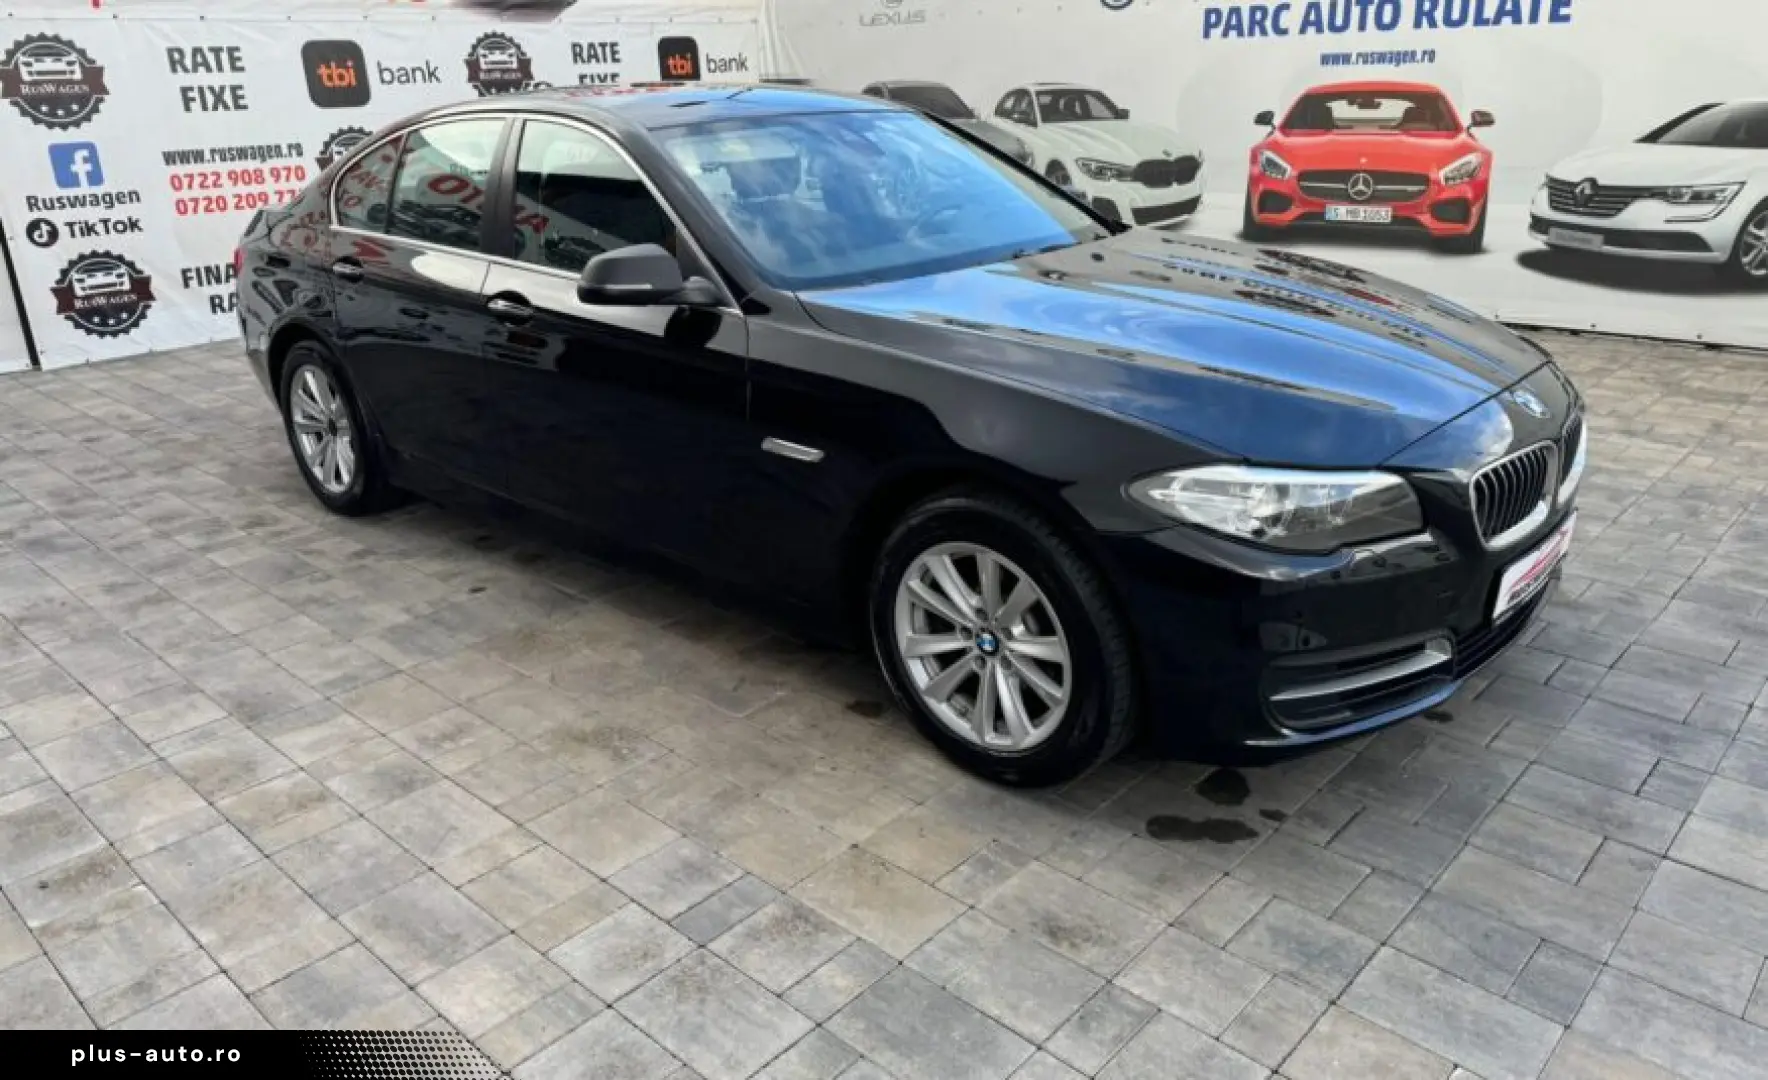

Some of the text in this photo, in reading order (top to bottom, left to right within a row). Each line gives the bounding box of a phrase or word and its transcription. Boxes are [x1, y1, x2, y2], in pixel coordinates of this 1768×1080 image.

[1202, 5, 1290, 39] PARC
[1298, 0, 1400, 35] AUTO
[166, 46, 246, 74] RATE
[571, 42, 621, 64] RATE
[668, 52, 693, 76] tbi
[706, 52, 750, 74] bank
[1319, 49, 1437, 67] www.ruswagen.ro
[317, 60, 357, 88] tbi
[377, 60, 442, 86] bank
[180, 85, 249, 112] FIXE
[161, 143, 304, 166] www.ruswagen.ro
[169, 164, 306, 192] 0722 908 970
[26, 190, 142, 213] Ruswagen
[175, 188, 302, 216] 0720 209 77
[64, 216, 144, 238] TikTok
